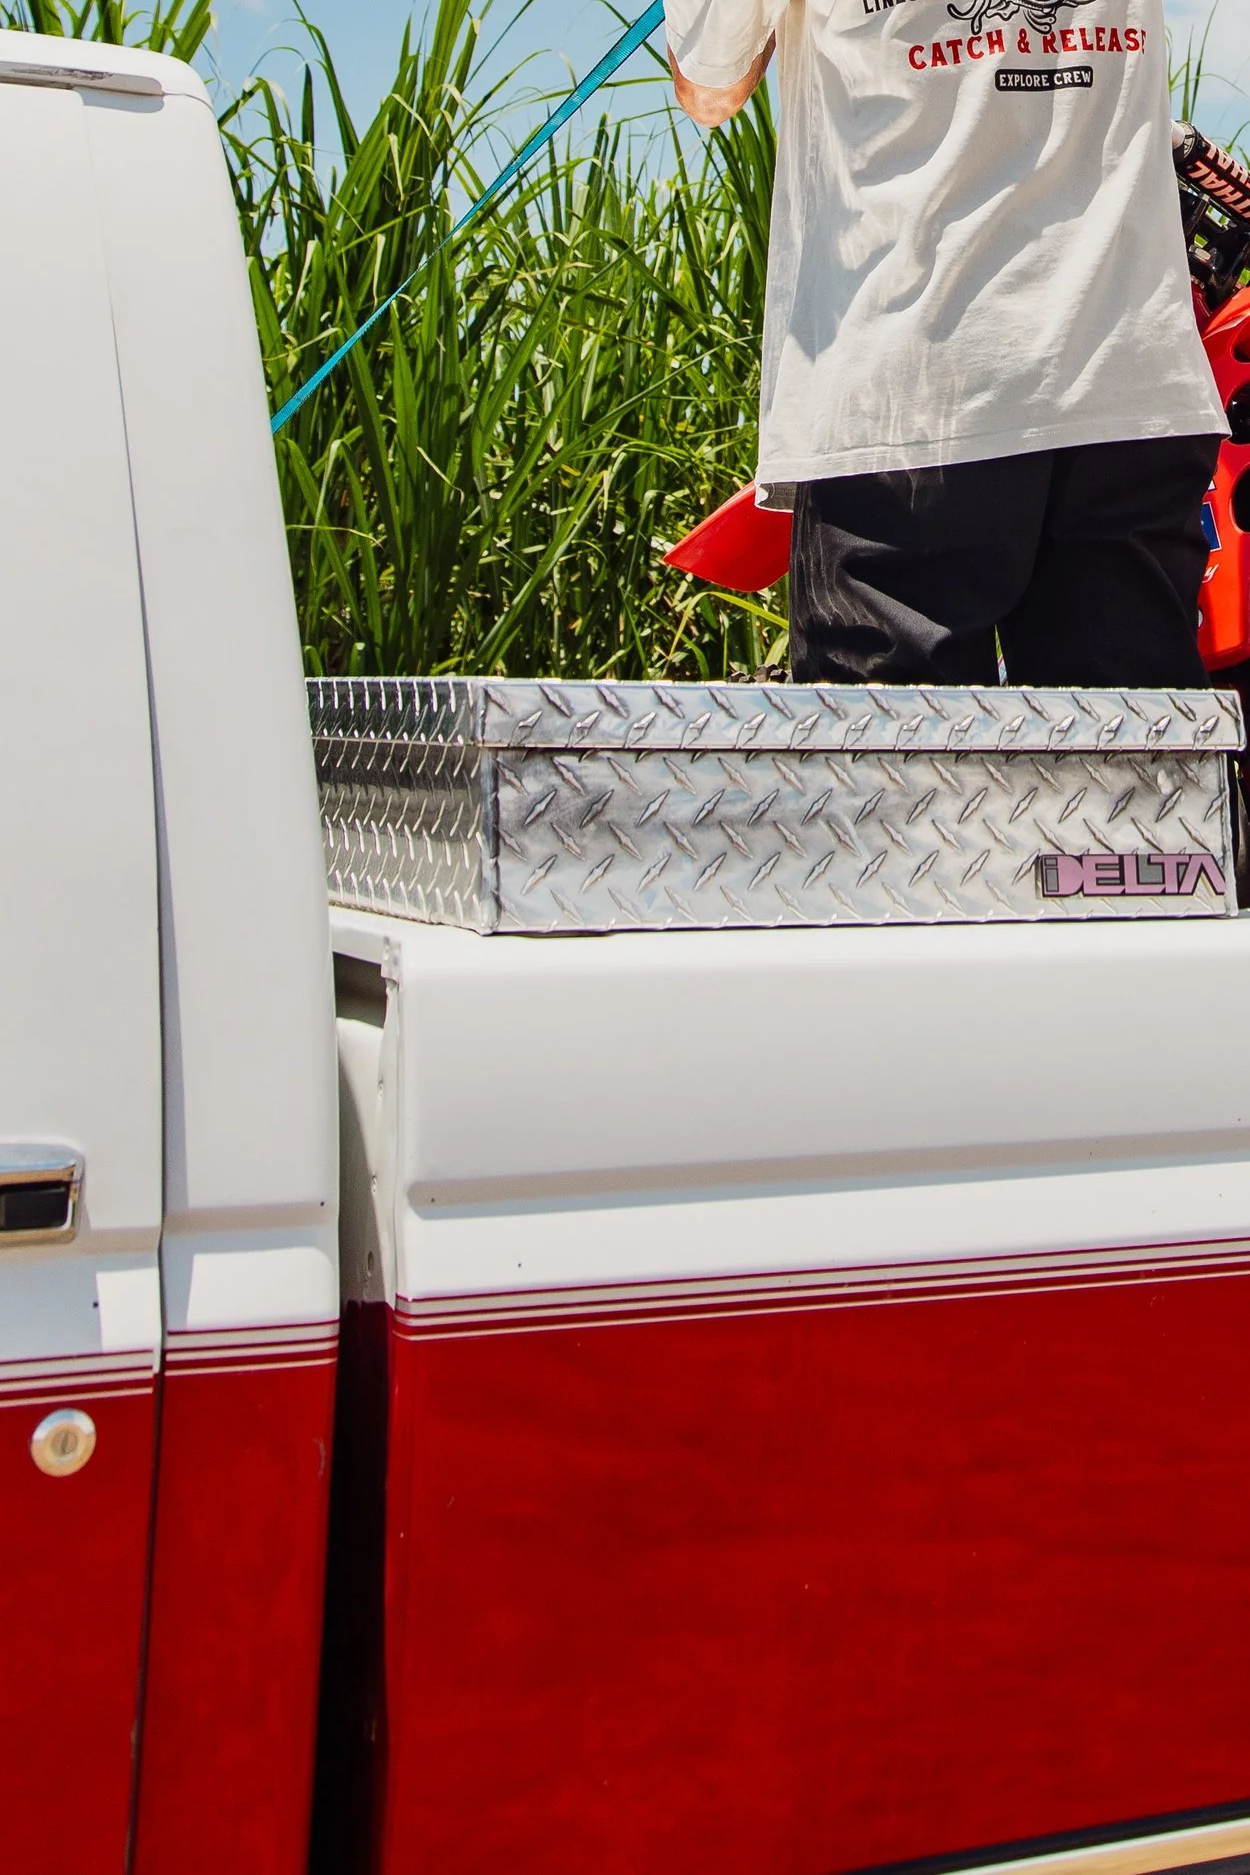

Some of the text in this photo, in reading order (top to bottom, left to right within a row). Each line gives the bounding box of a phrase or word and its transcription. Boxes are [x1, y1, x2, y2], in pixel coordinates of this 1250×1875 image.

[908, 28, 1005, 70] CATCH
[1017, 28, 1031, 54] &
[1000, 70, 1091, 87] EXPLORE CREW
[1042, 854, 1225, 897] DELTA
